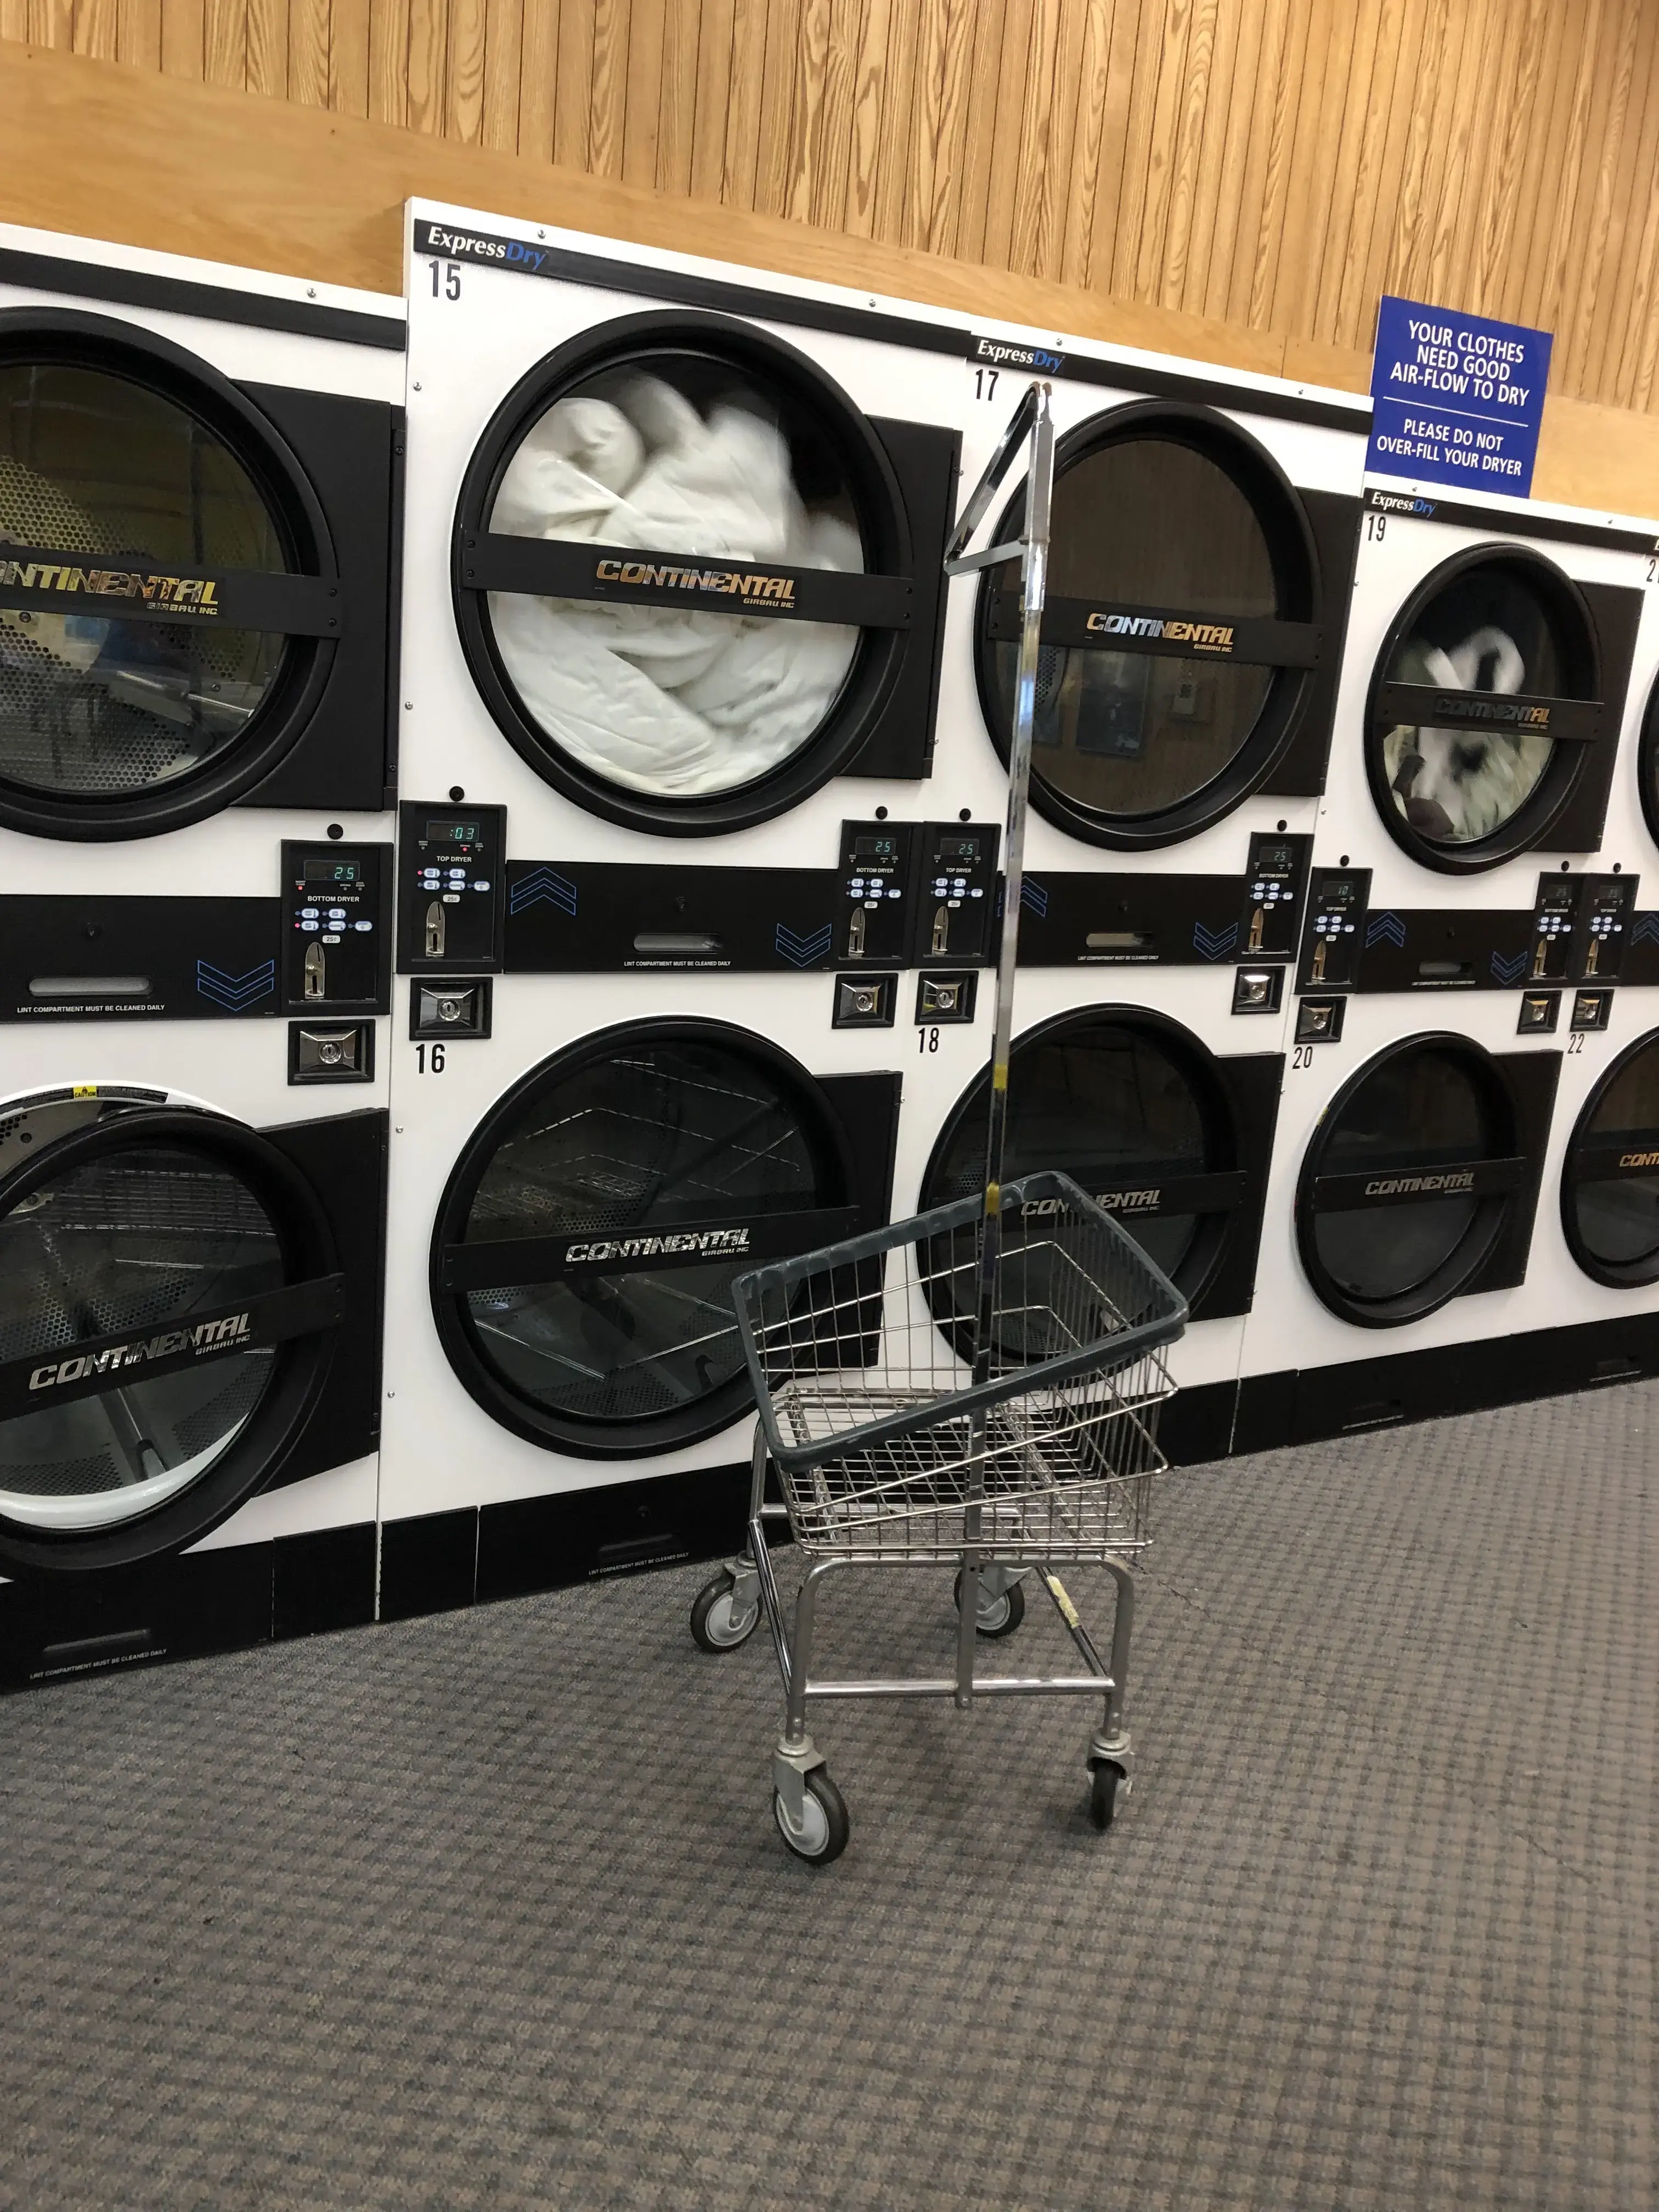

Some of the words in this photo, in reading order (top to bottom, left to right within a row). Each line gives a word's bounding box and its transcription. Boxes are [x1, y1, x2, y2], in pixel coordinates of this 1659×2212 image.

[428, 226, 547, 270] ExpressDry
[429, 261, 460, 301] 15
[978, 340, 1063, 373] ExpressDry
[1409, 320, 1453, 347] YOUR
[1458, 331, 1525, 364] CLOTHES
[1417, 345, 1459, 370] NEED
[1463, 356, 1510, 381] GOOD
[975, 369, 1000, 401] 17
[1390, 362, 1469, 394] AIR-FLOW
[1473, 378, 1493, 399] TO
[1498, 384, 1530, 407] DRY
[1404, 419, 1450, 442] PLEASE
[1454, 428, 1473, 445] DO
[1476, 434, 1504, 452] NOT
[1376, 436, 1440, 461] OVER-FILL
[1444, 448, 1479, 469] YOUR
[1482, 455, 1522, 476] DRYER
[1372, 492, 1434, 518] ExpressDry
[1368, 515, 1386, 541] 19
[596, 560, 795, 600] CONTINENTAL
[1086, 613, 1234, 645] CONTINENTAL
[1435, 699, 1550, 723] CONTINENTAL
[876, 842, 890, 852] 25
[959, 844, 973, 854] 25
[335, 866, 354, 879] 25
[919, 1028, 939, 1053] 18
[1567, 1034, 1584, 1054] 22
[416, 1044, 445, 1074] 16
[1292, 1046, 1313, 1069] 20
[1365, 1172, 1474, 1195] CONTINENTAL
[565, 1228, 750, 1262] CONTINENTAL
[29, 1313, 251, 1391] CONTINENTAL
[45, 1663, 92, 1675] COMPARTMENT
[93, 1659, 110, 1667] MUST
[121, 1652, 149, 1662] CLEANED
